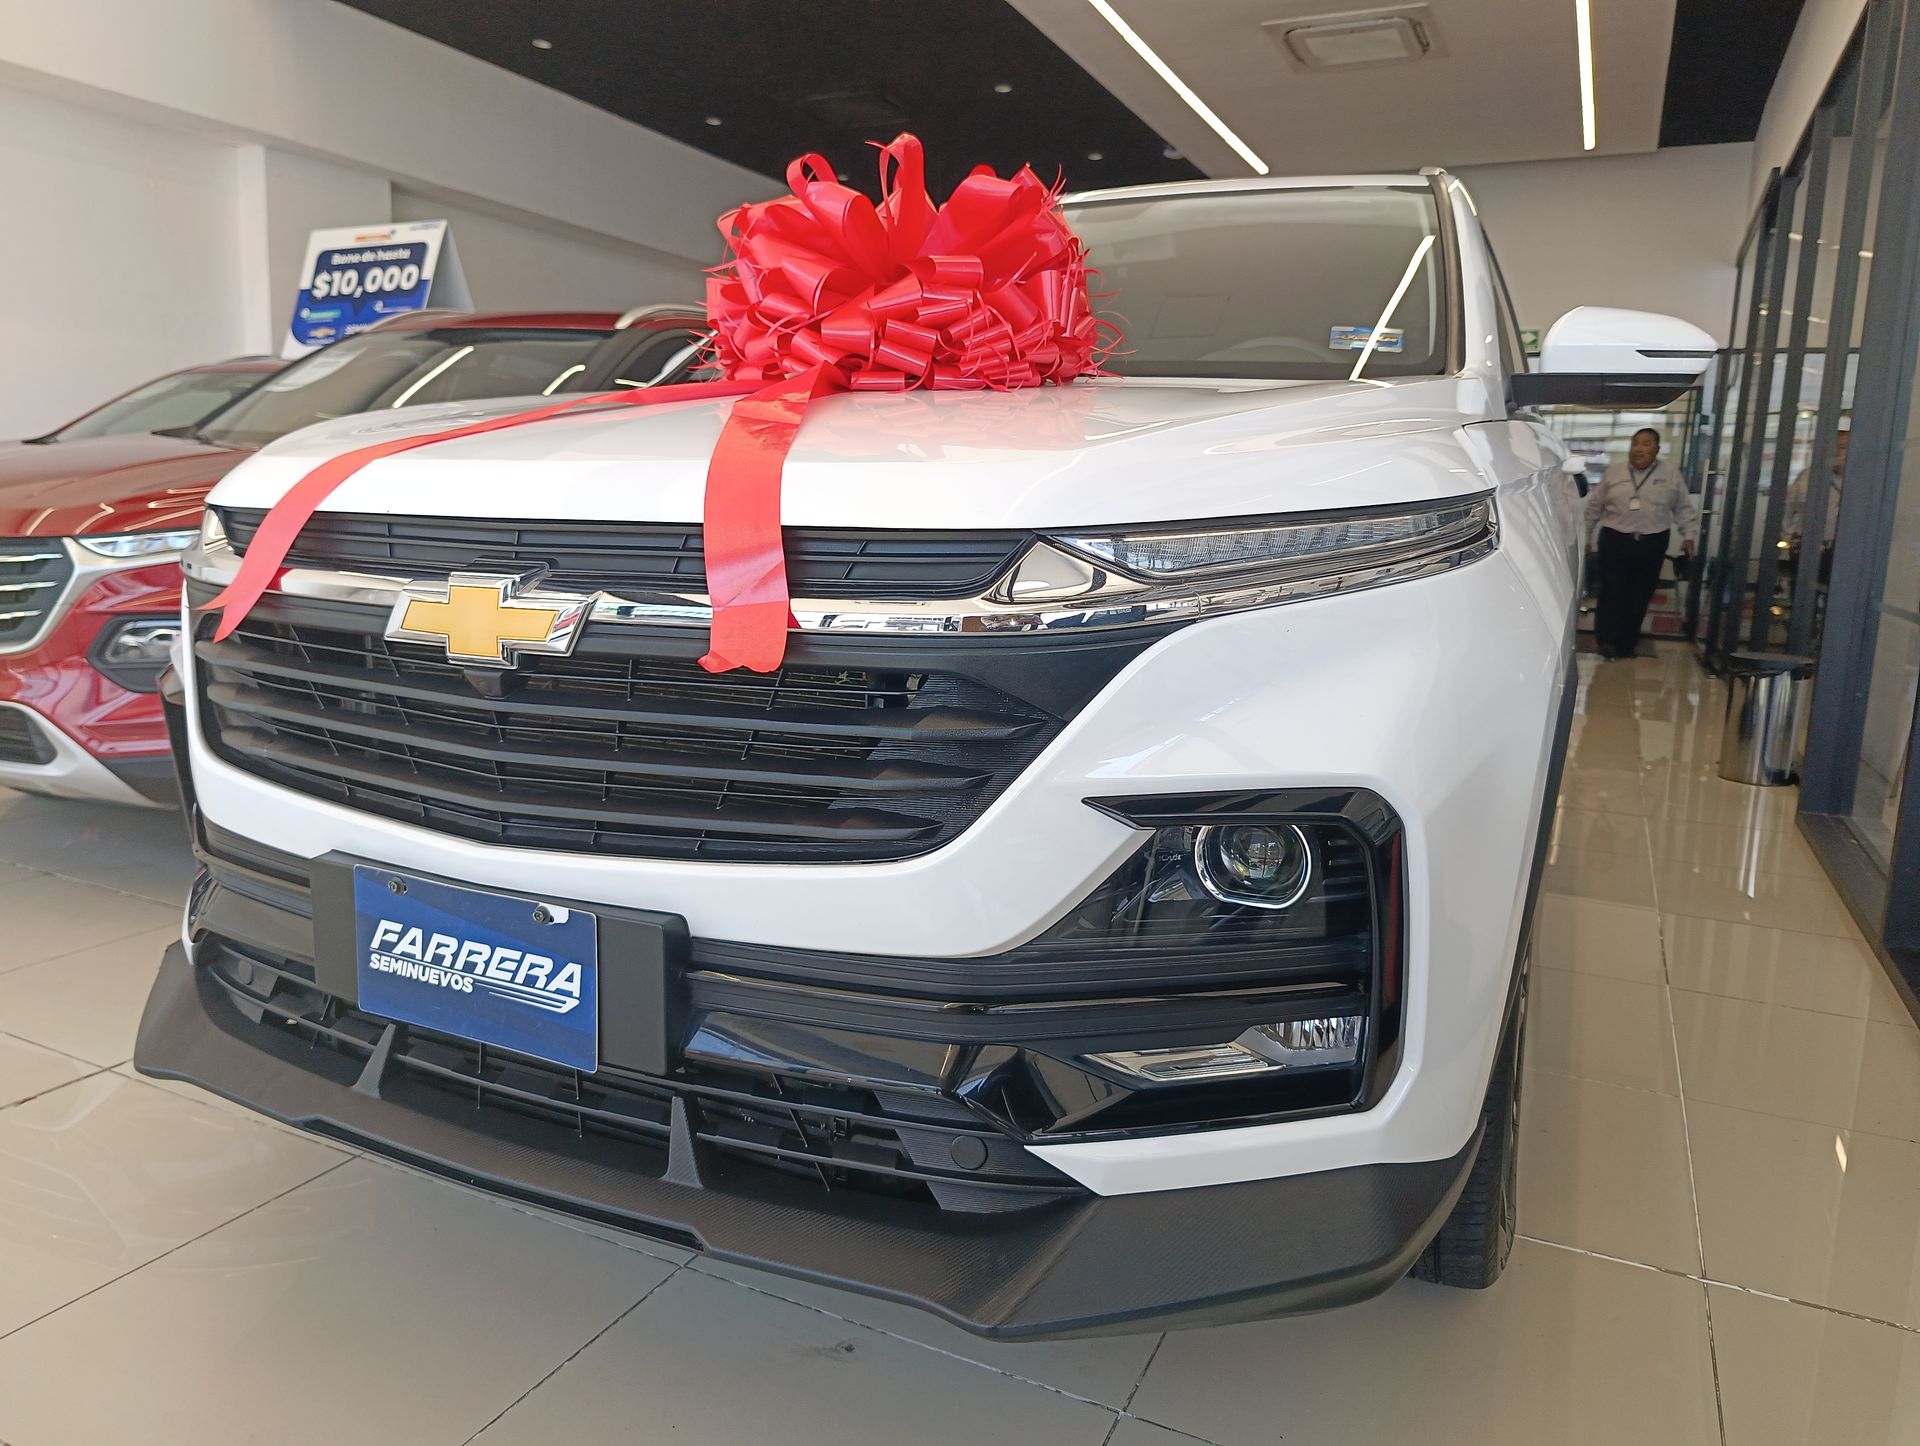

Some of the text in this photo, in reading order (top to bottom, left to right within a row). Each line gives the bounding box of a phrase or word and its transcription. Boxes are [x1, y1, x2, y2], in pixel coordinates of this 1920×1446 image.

[361, 251, 376, 262] de
[313, 265, 419, 299] $10,000
[369, 953, 474, 993] SEMINUEVOS
[370, 920, 582, 998] FARRERA
